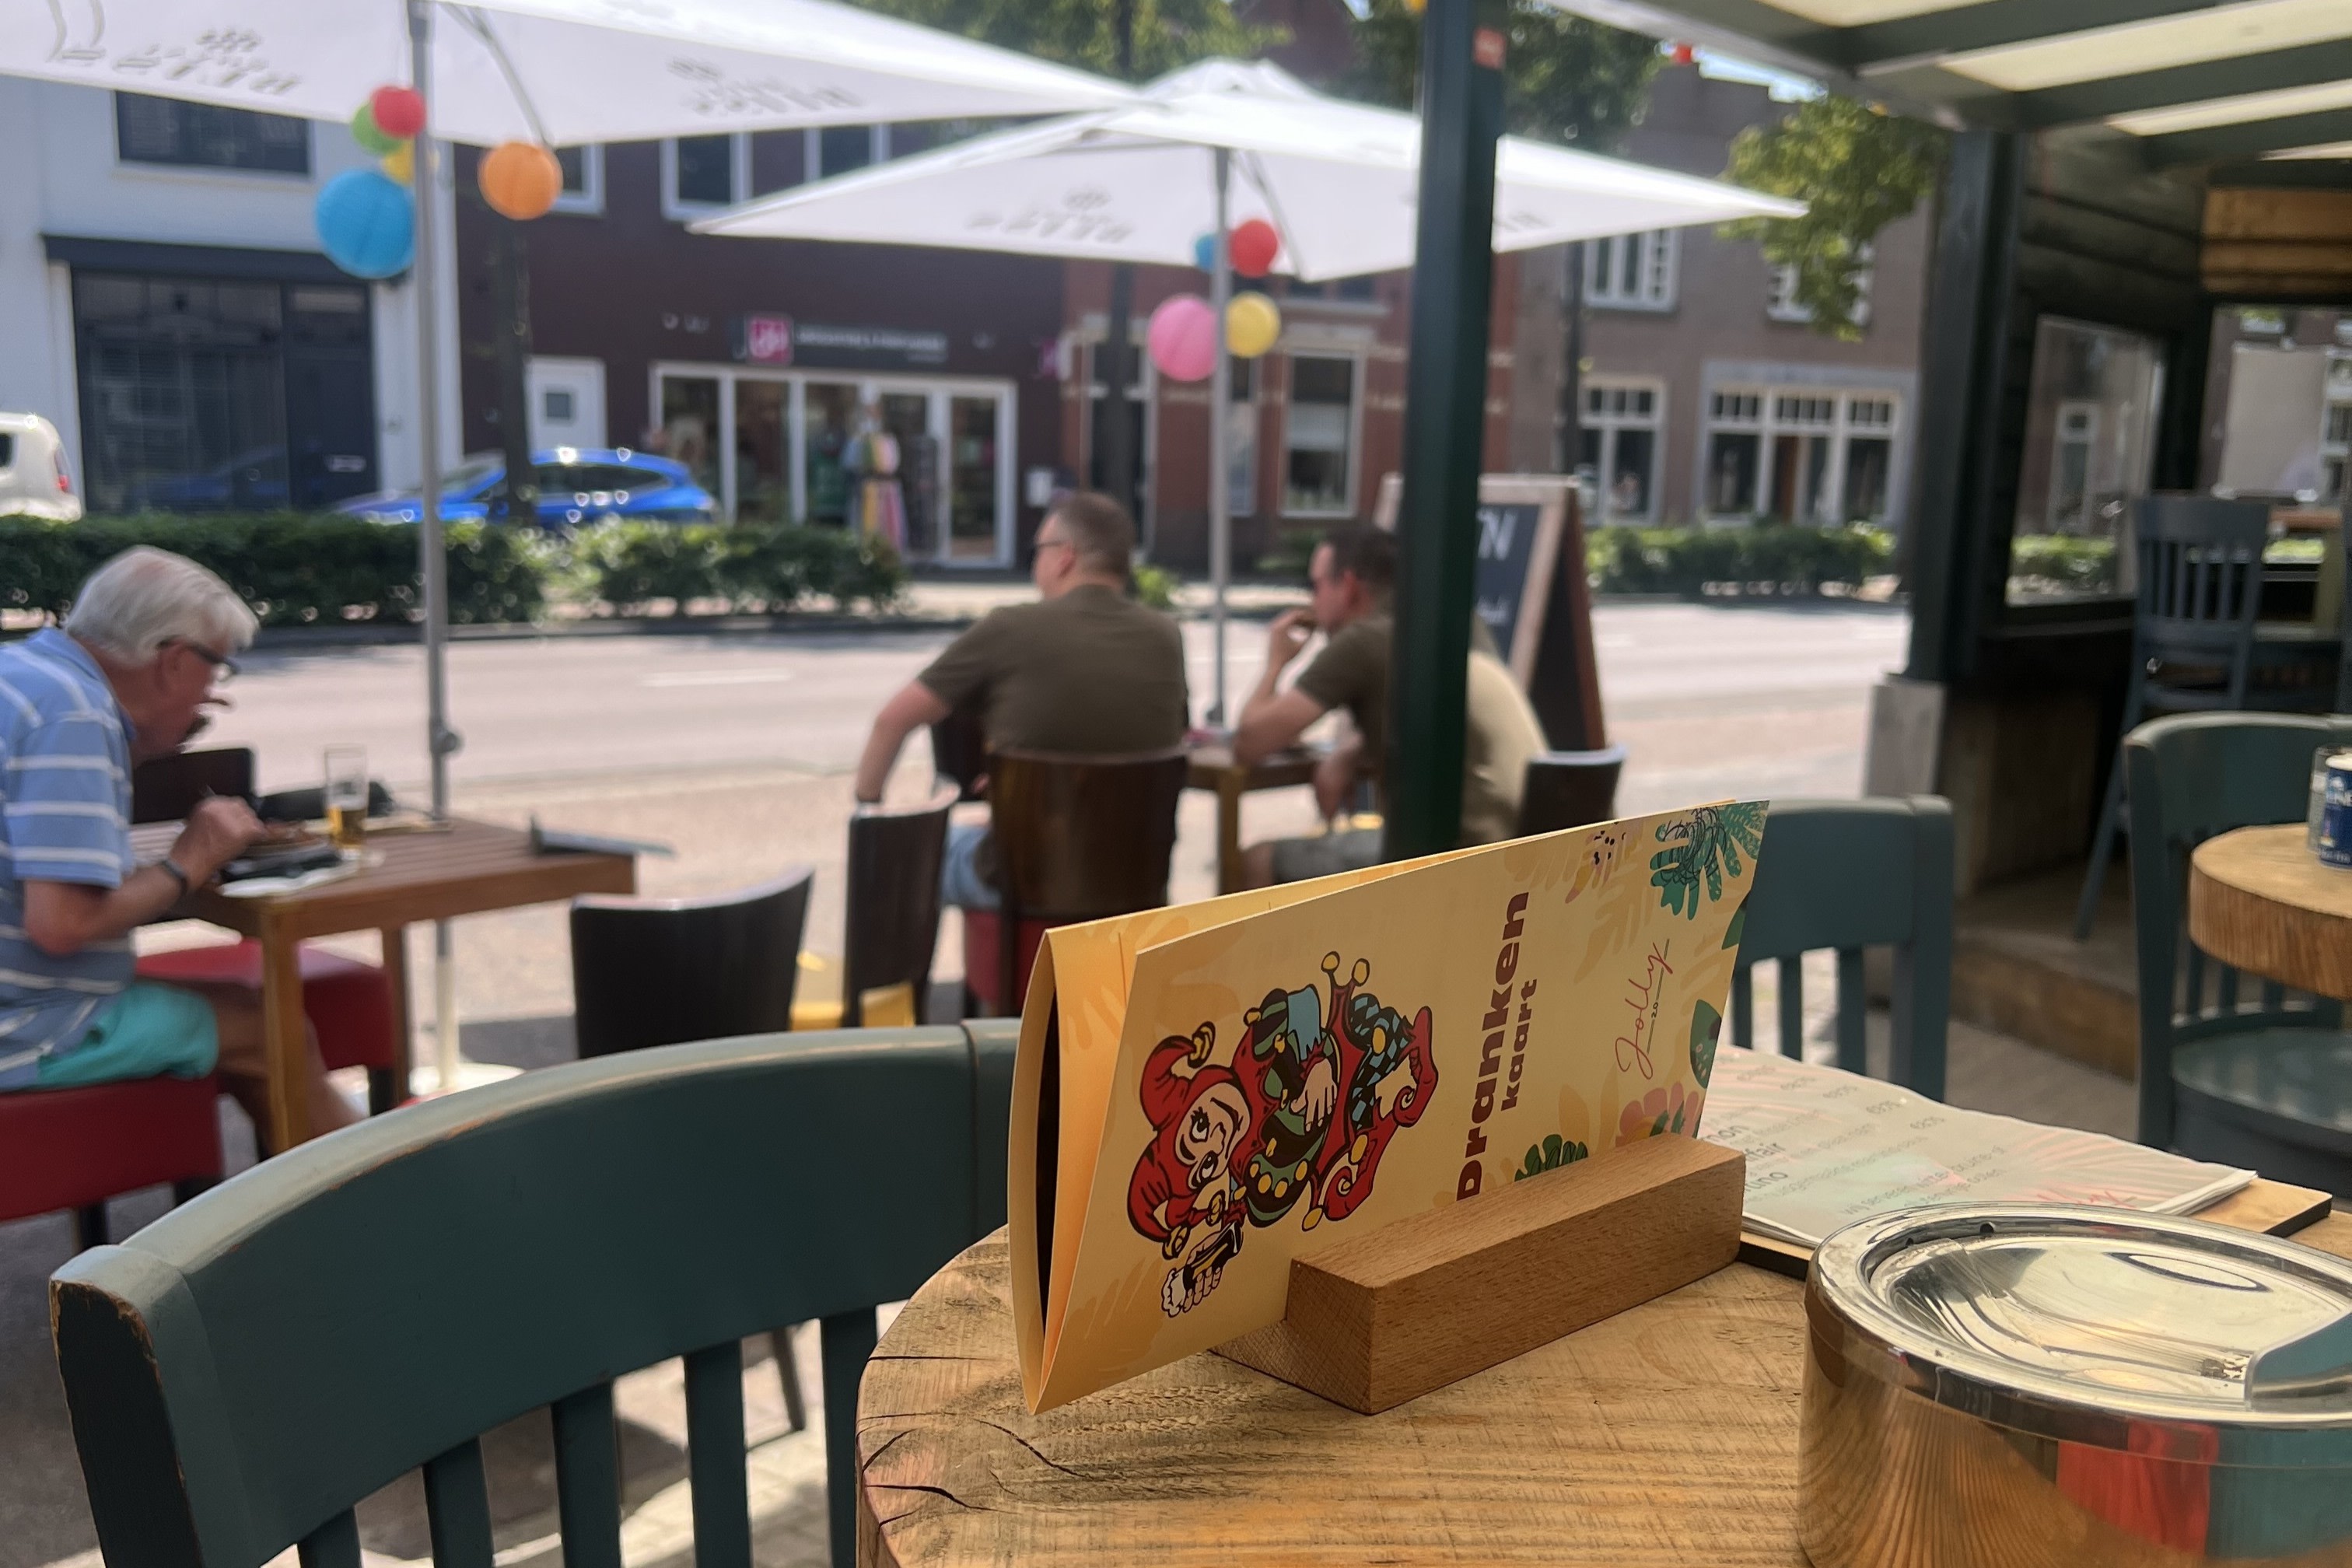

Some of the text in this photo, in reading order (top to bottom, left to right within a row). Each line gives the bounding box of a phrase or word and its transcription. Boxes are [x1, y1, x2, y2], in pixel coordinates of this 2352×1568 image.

[1457, 892, 1528, 1201] Dranken
[1501, 978, 1537, 1111] kaart
[1615, 942, 1673, 1080] Jolly
